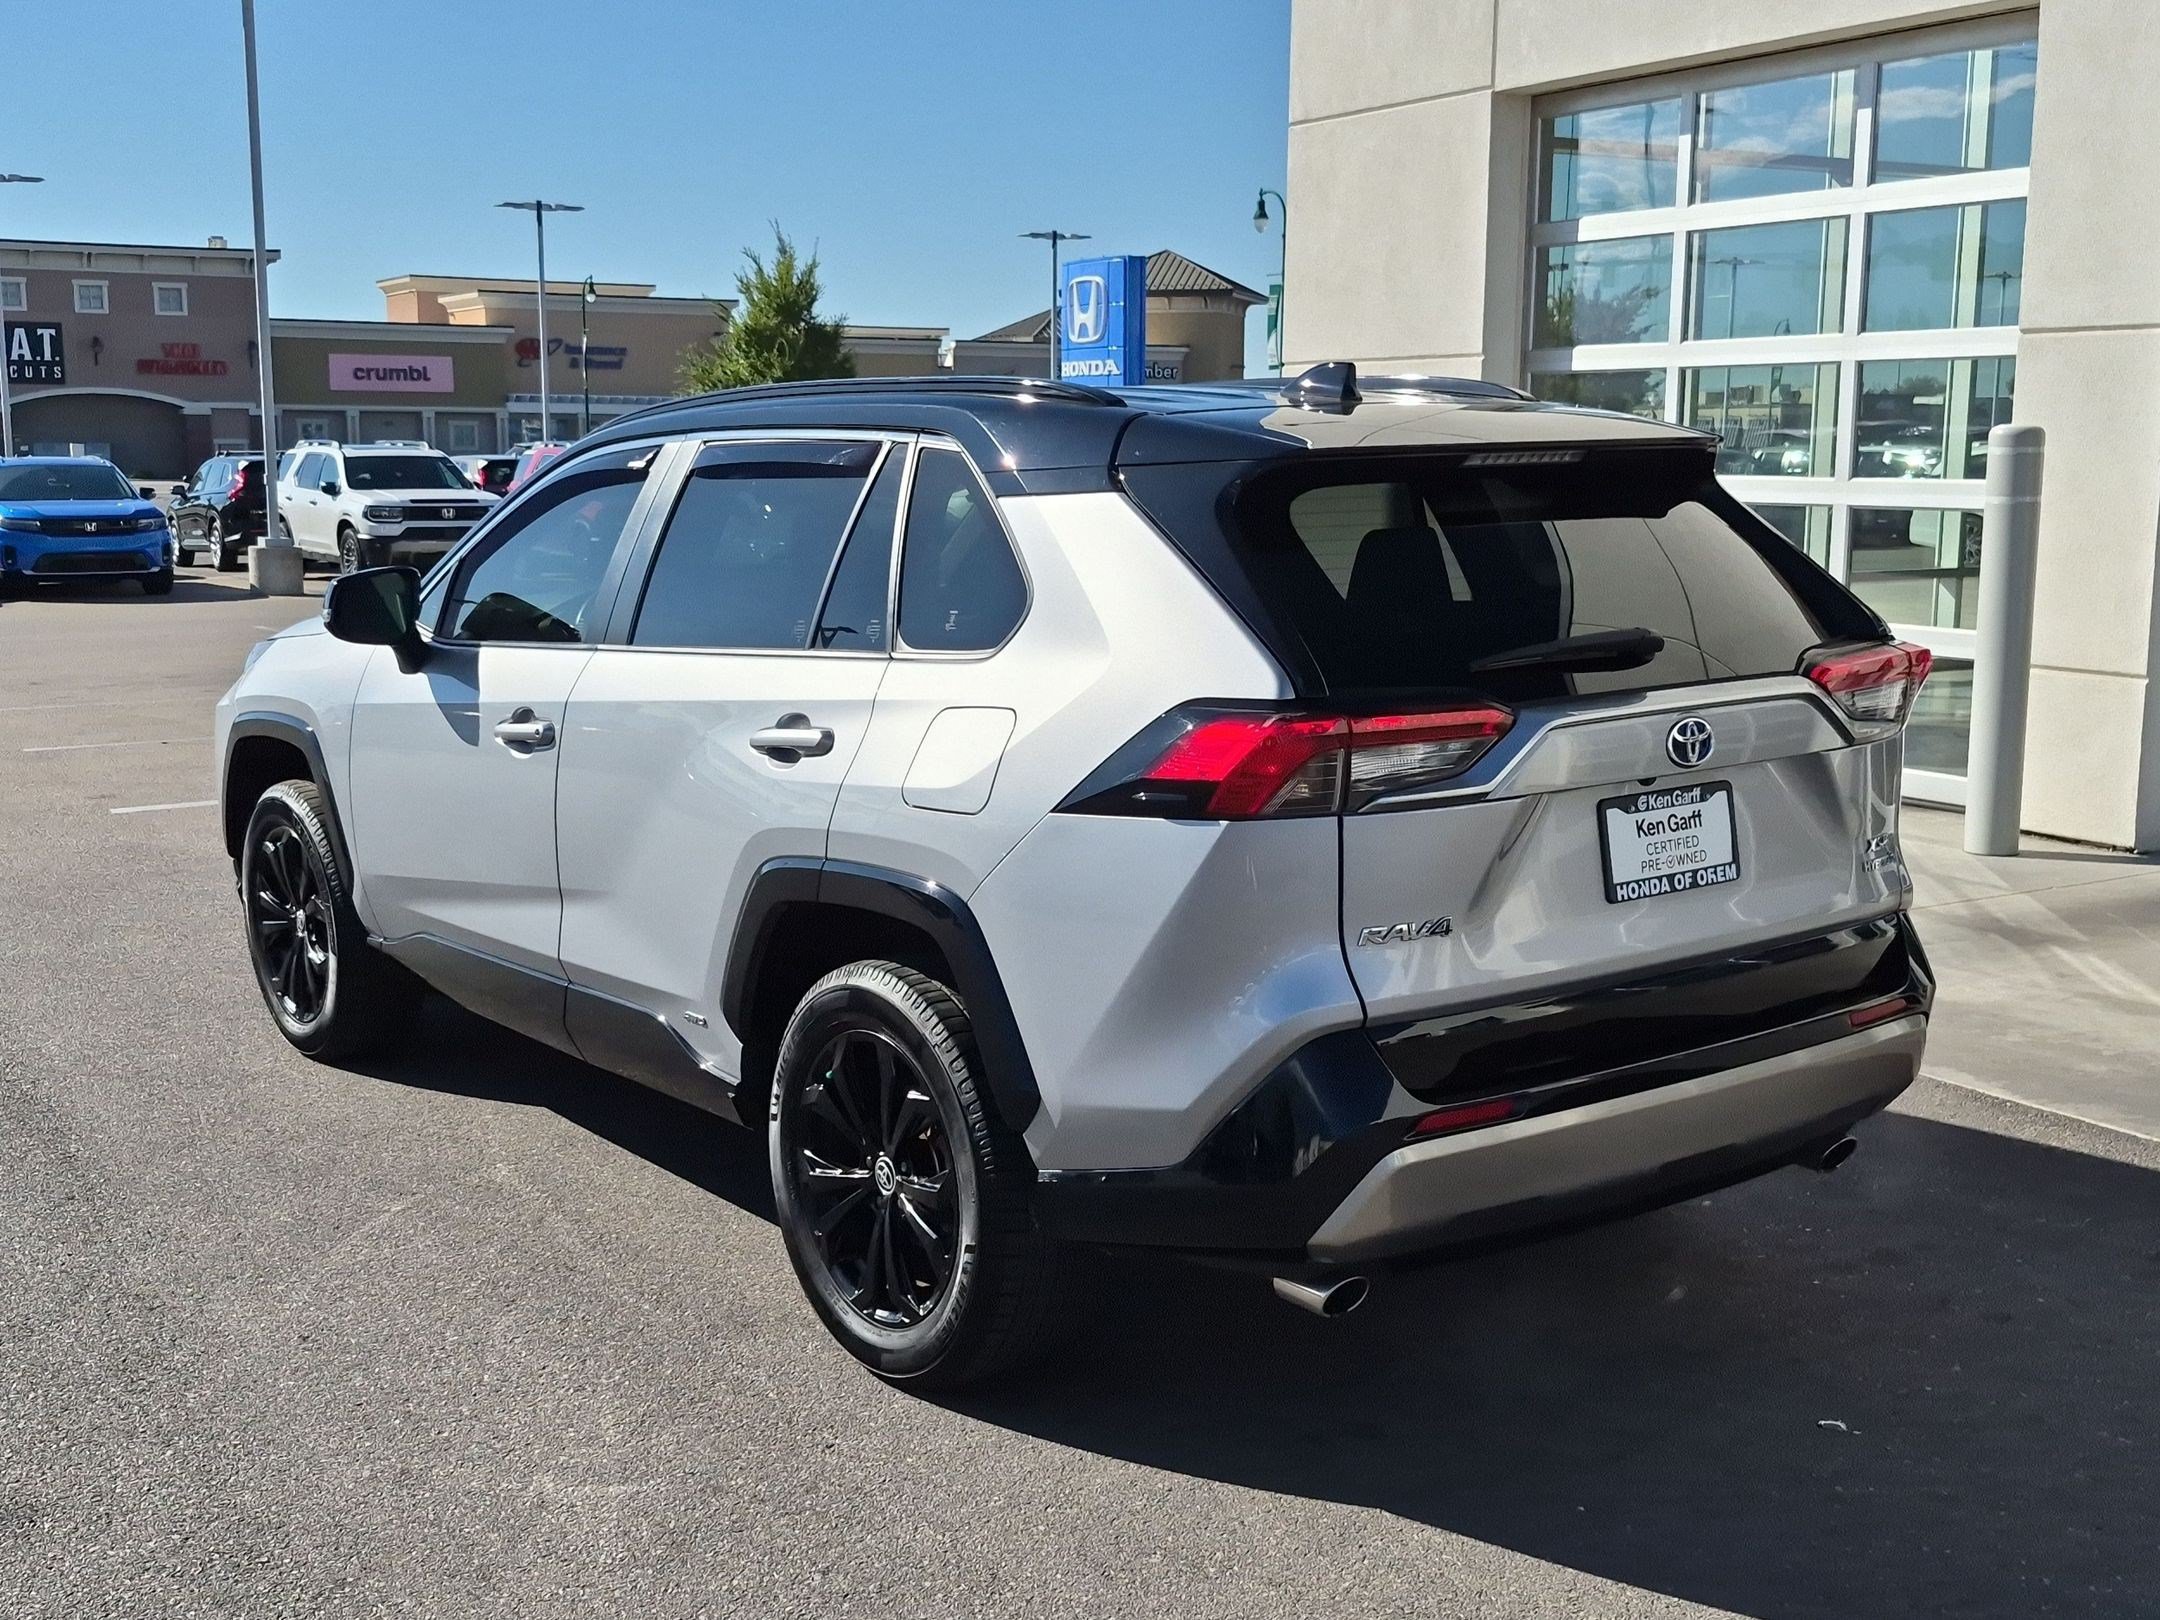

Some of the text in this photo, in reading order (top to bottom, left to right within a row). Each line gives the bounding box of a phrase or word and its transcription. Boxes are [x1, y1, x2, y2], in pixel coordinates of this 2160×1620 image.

[9, 365, 62, 379] CUTS
[352, 365, 432, 382] crumbl
[1061, 358, 1121, 378] HONDA
[1648, 786, 1702, 810] Ken Garff
[1635, 809, 1703, 838] Ken Garff
[1645, 834, 1700, 856] CERTIFIED
[1616, 863, 1738, 902] HONDA OF OREM
[1357, 915, 1453, 946] RAV4
